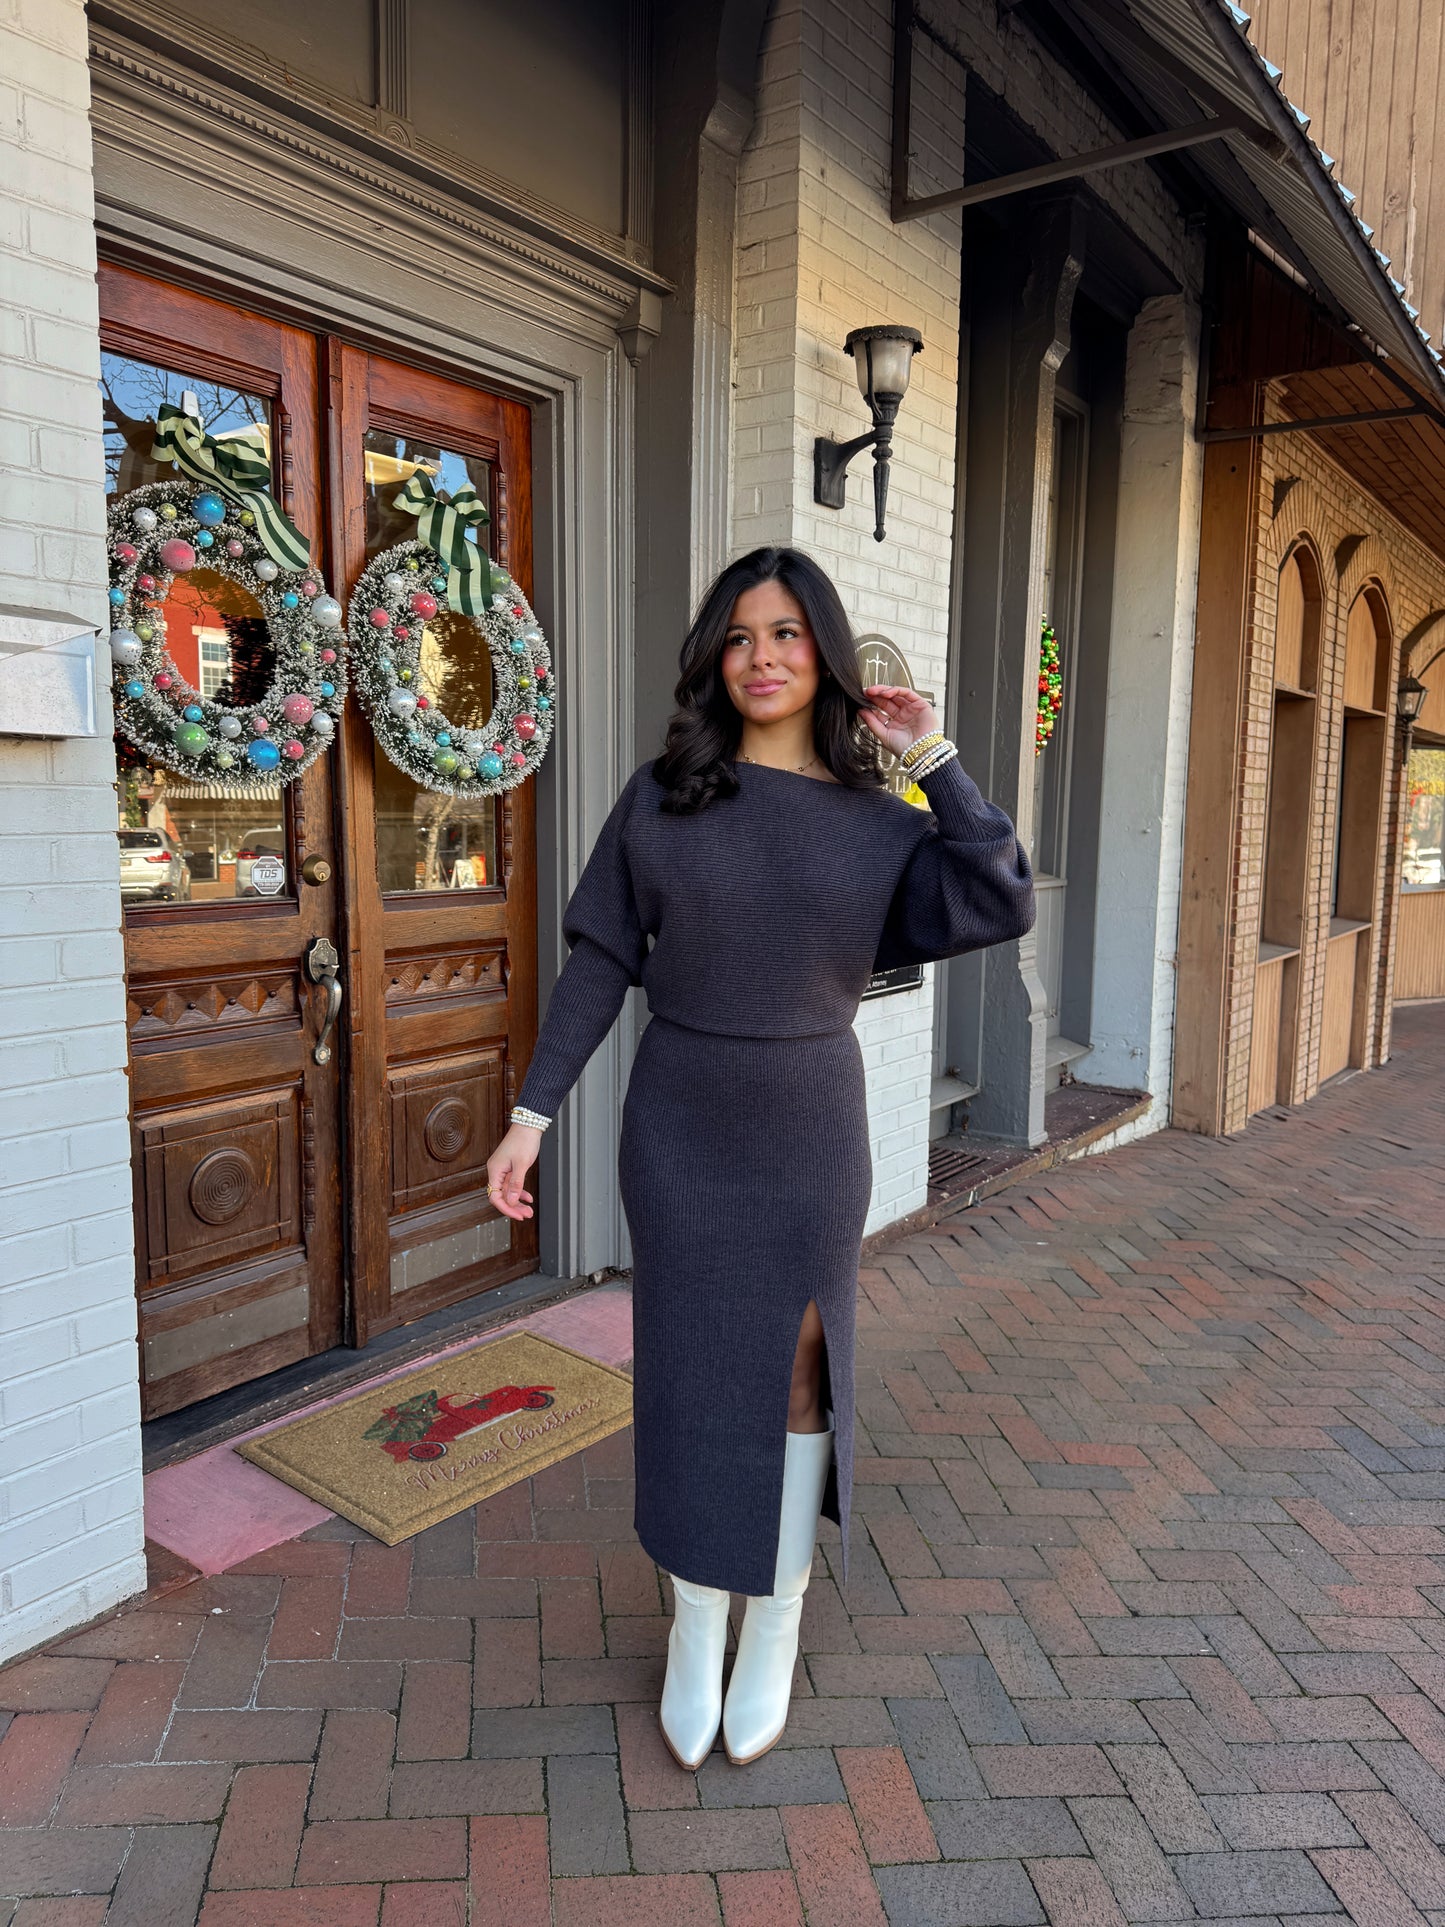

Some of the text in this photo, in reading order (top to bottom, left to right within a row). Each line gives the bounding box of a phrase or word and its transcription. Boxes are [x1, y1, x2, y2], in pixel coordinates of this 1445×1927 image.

[260, 869, 278, 879] TDS
[405, 1397, 600, 1491] Merry Christmas
